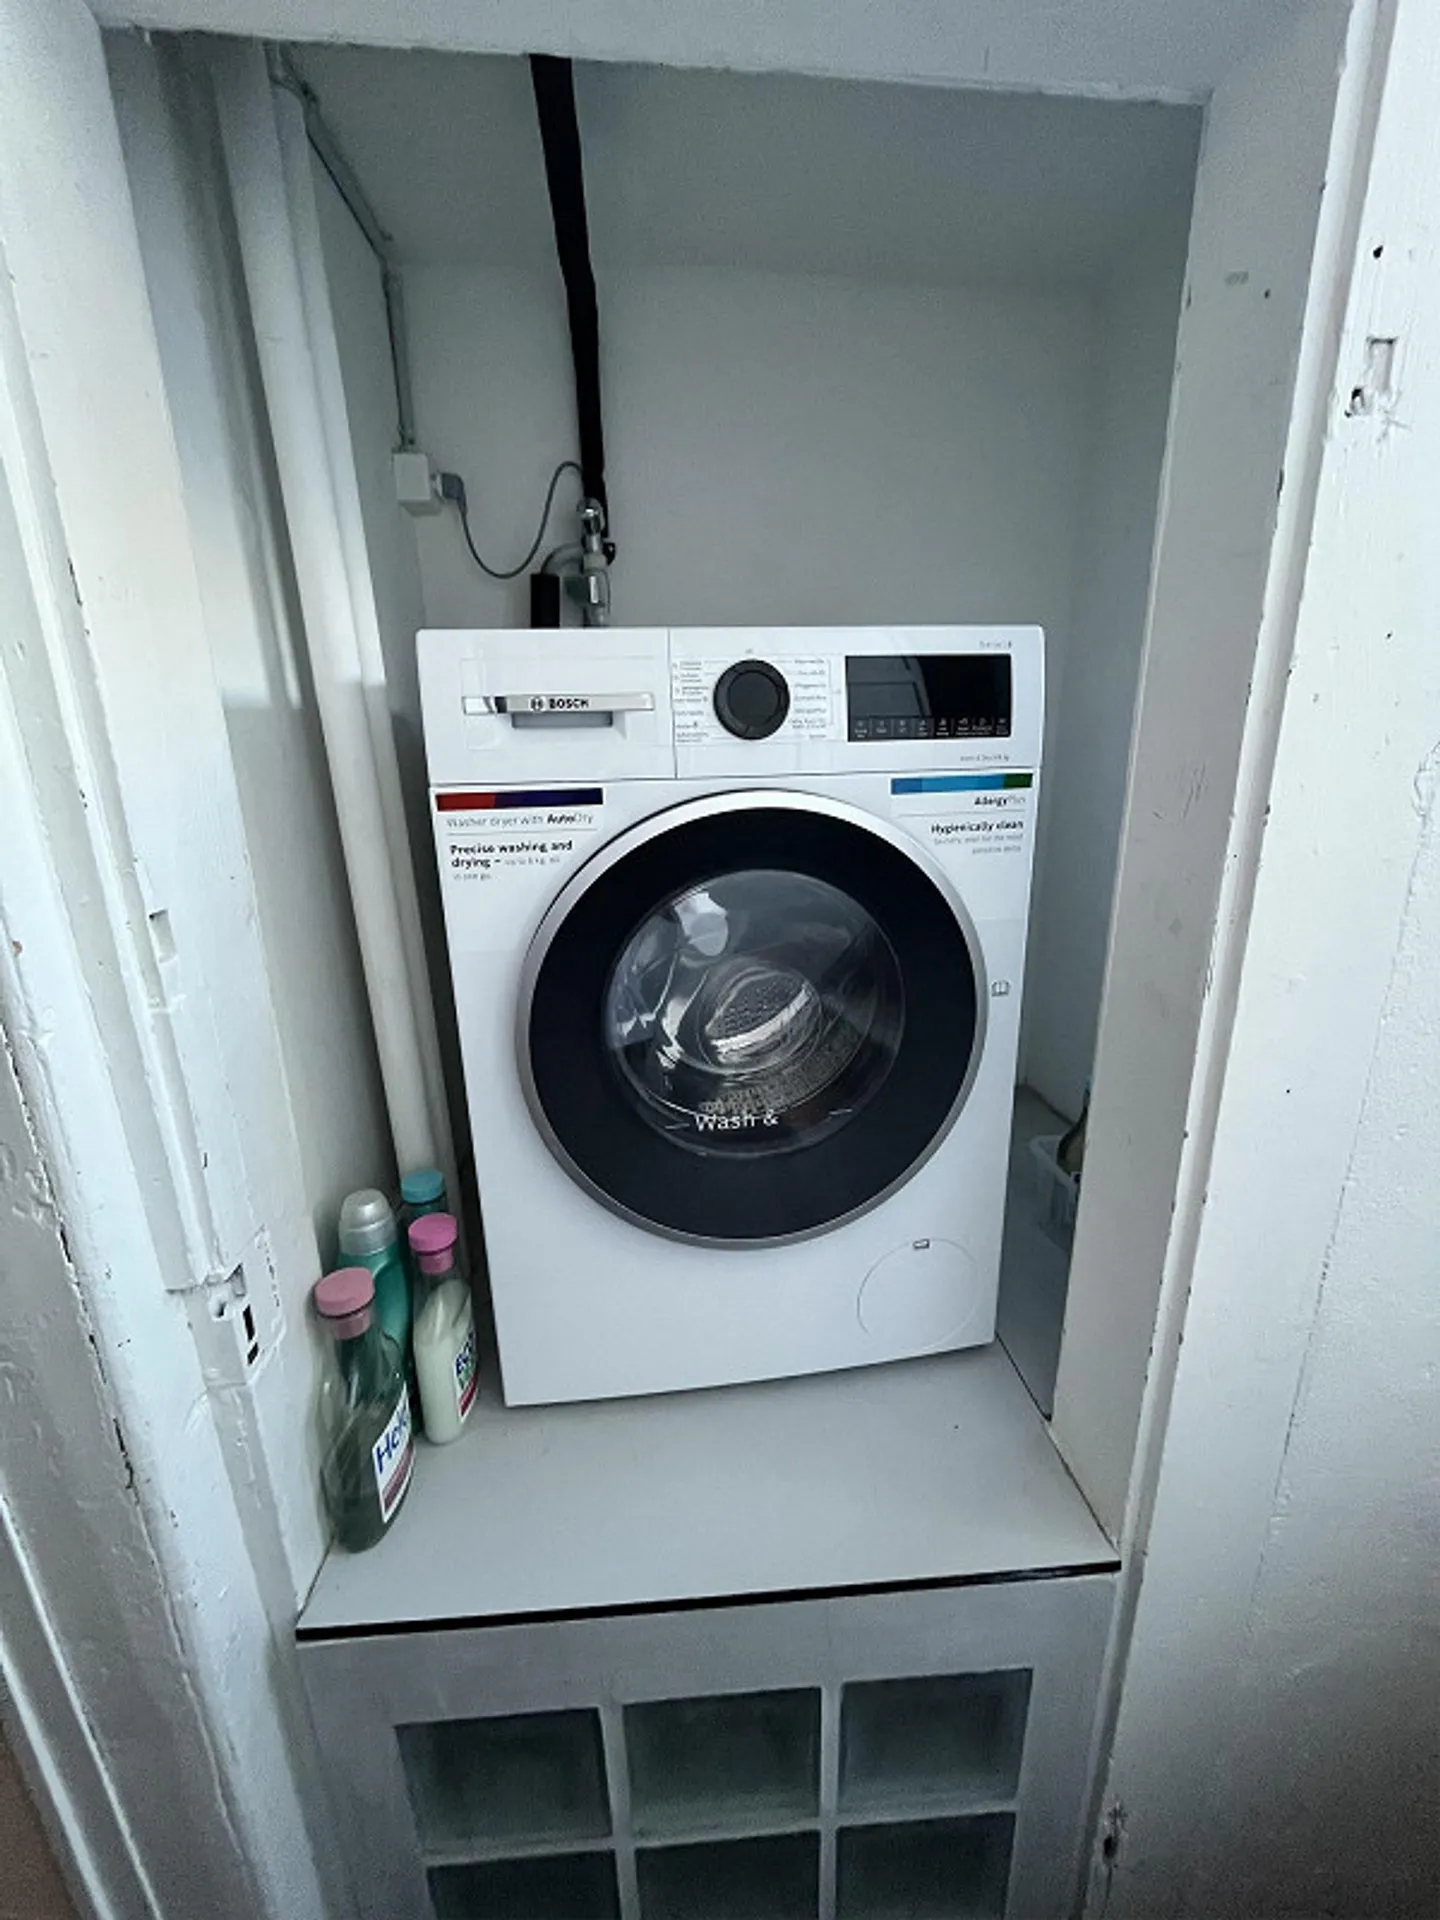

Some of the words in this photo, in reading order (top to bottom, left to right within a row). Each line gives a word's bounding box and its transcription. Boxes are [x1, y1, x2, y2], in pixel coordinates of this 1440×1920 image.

[549, 697, 589, 709] BOSCH
[931, 821, 994, 835] Hygienically
[996, 820, 1024, 830] clean
[449, 844, 495, 855] Precise
[499, 841, 548, 854] washing
[551, 840, 573, 851] and
[451, 857, 491, 869] drying
[694, 1111, 756, 1131] Wash
[763, 1109, 779, 1127] &
